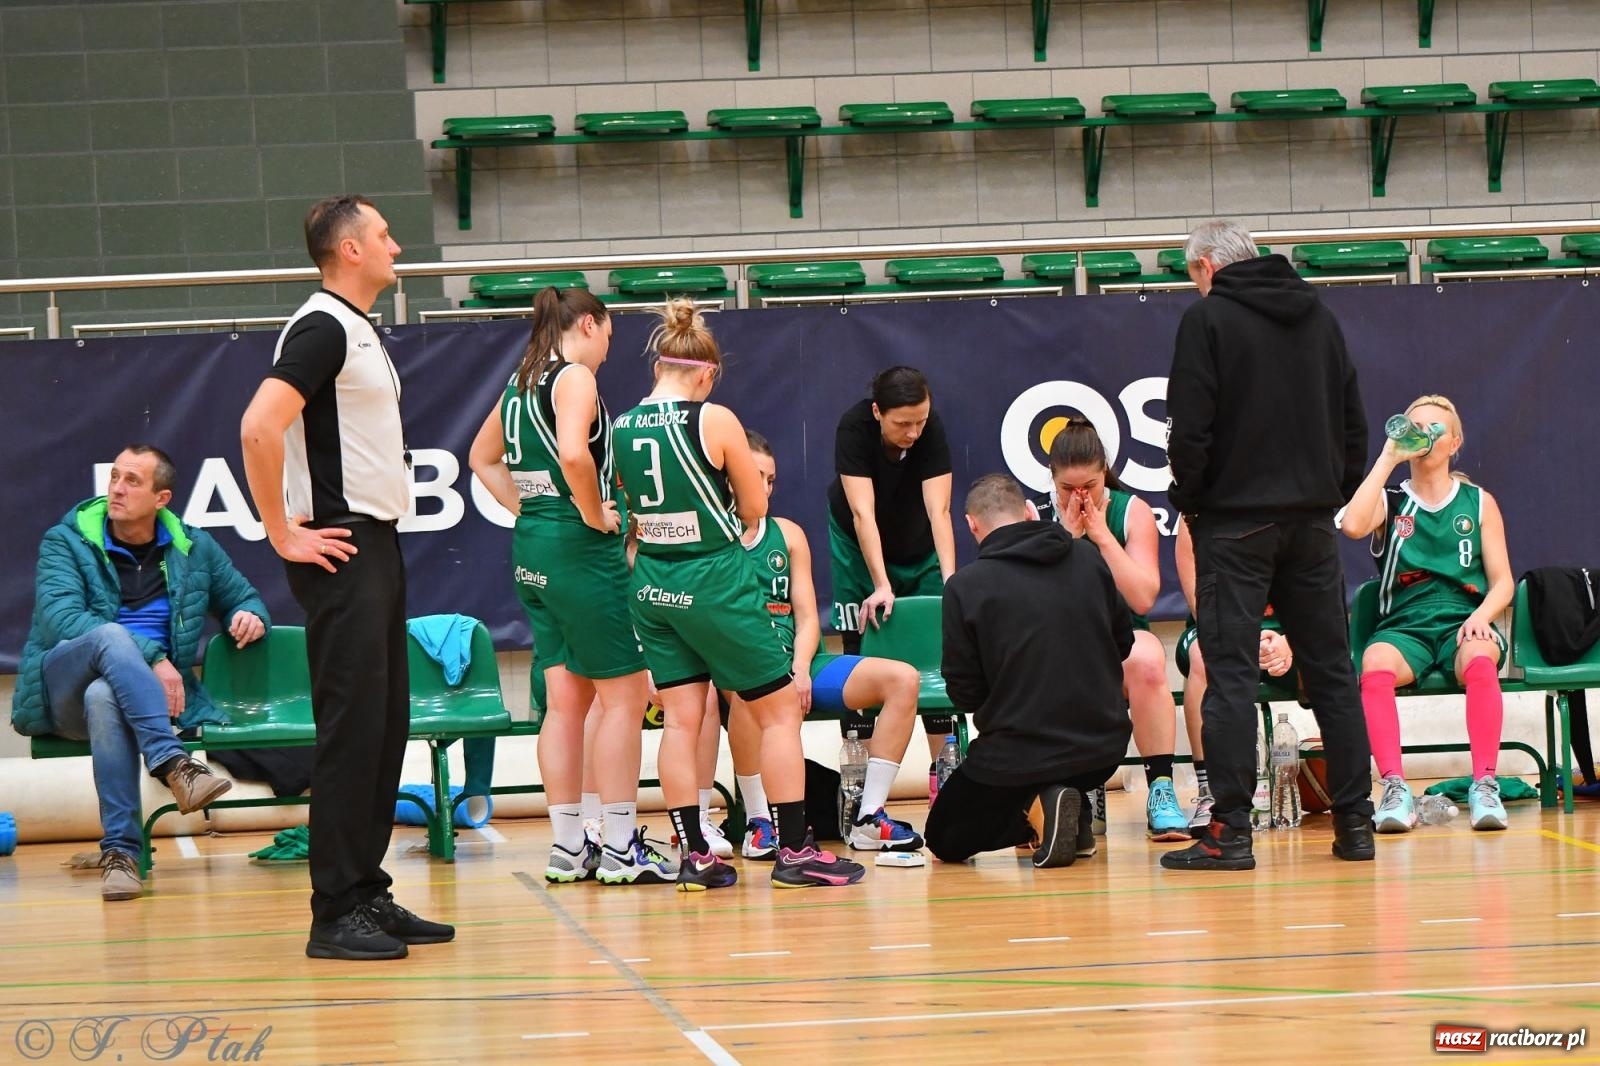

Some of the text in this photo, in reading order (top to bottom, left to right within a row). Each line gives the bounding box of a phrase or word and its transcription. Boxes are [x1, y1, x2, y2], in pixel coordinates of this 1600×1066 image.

[505, 396, 522, 465] 9
[632, 437, 665, 508] 3
[1458, 538, 1473, 568] 8
[648, 588, 694, 606] Clavis
[834, 601, 860, 632] 30
